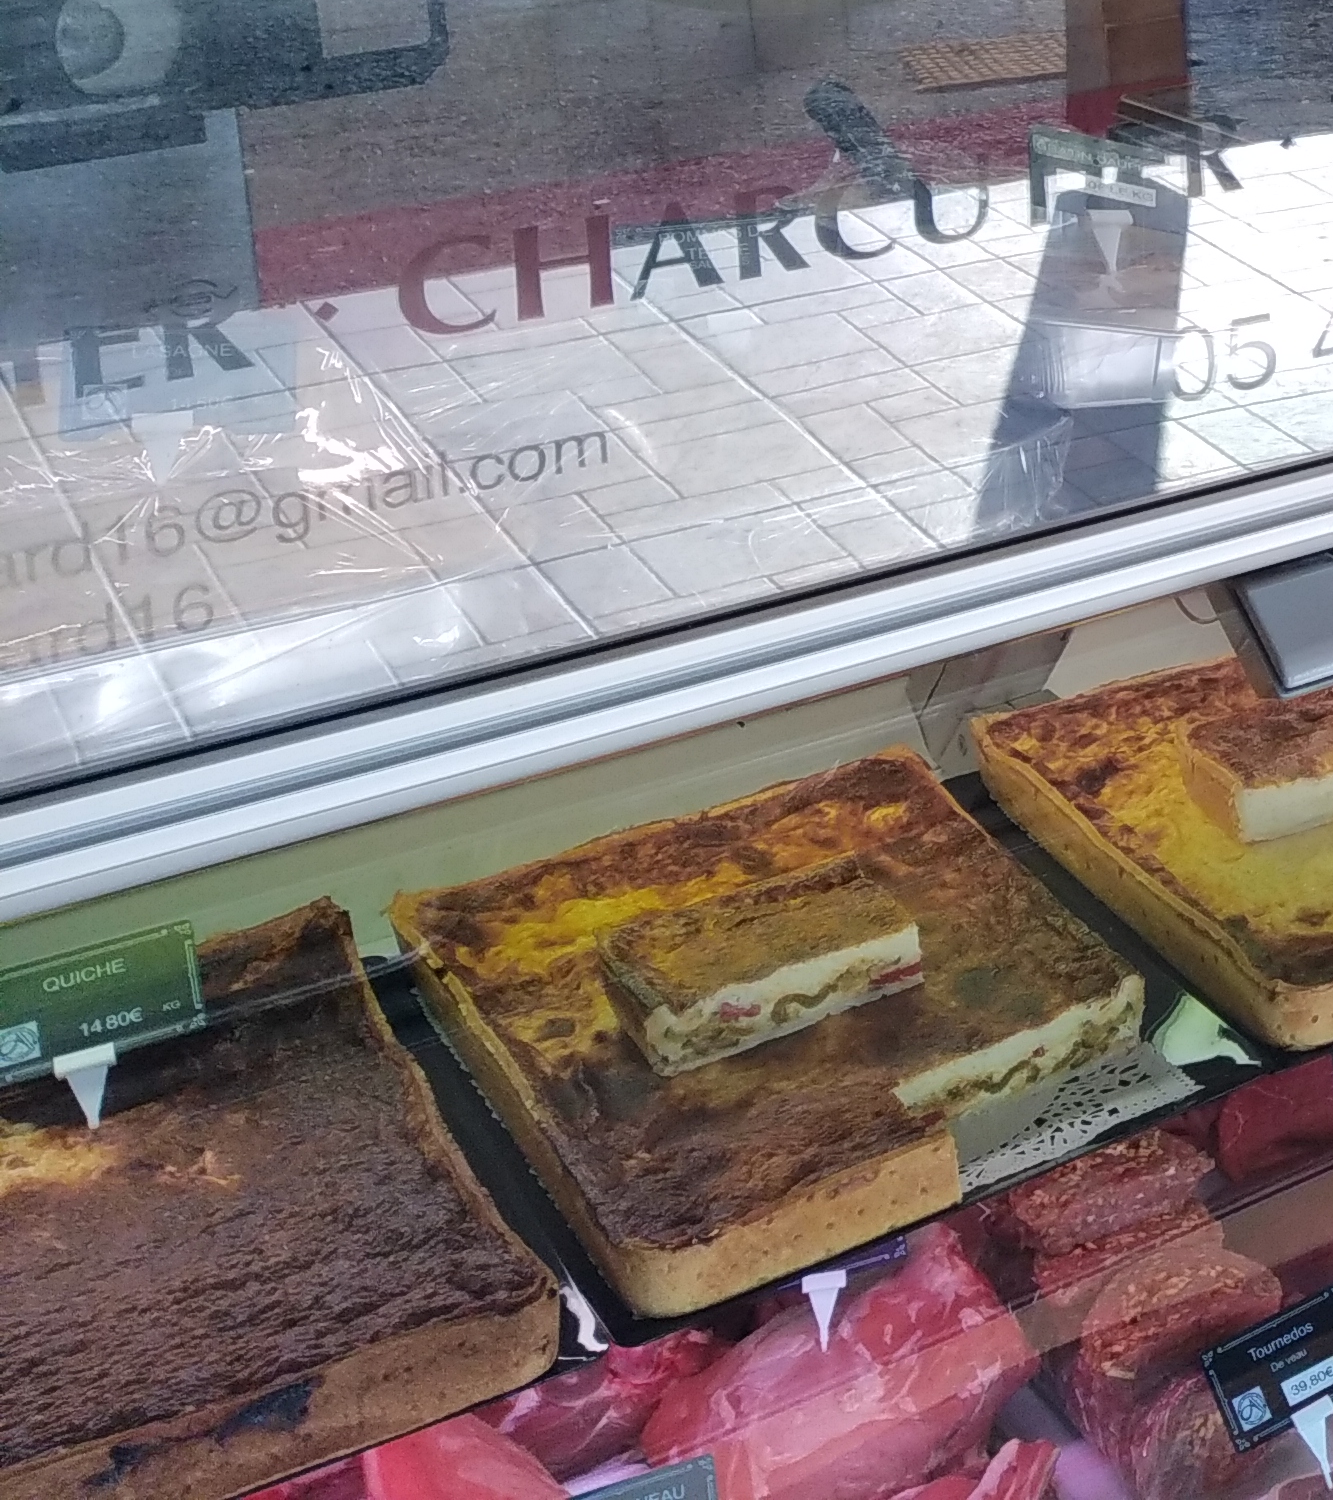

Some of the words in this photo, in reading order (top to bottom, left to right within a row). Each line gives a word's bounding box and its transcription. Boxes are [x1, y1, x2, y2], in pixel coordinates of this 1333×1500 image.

[1170, 312, 1277, 400] 05
[42, 957, 127, 993] QUICHE
[162, 999, 182, 1012] KG
[1246, 1321, 1315, 1362] Tournedos
[1269, 1360, 1285, 1373] De
[1284, 1348, 1308, 1366] veau
